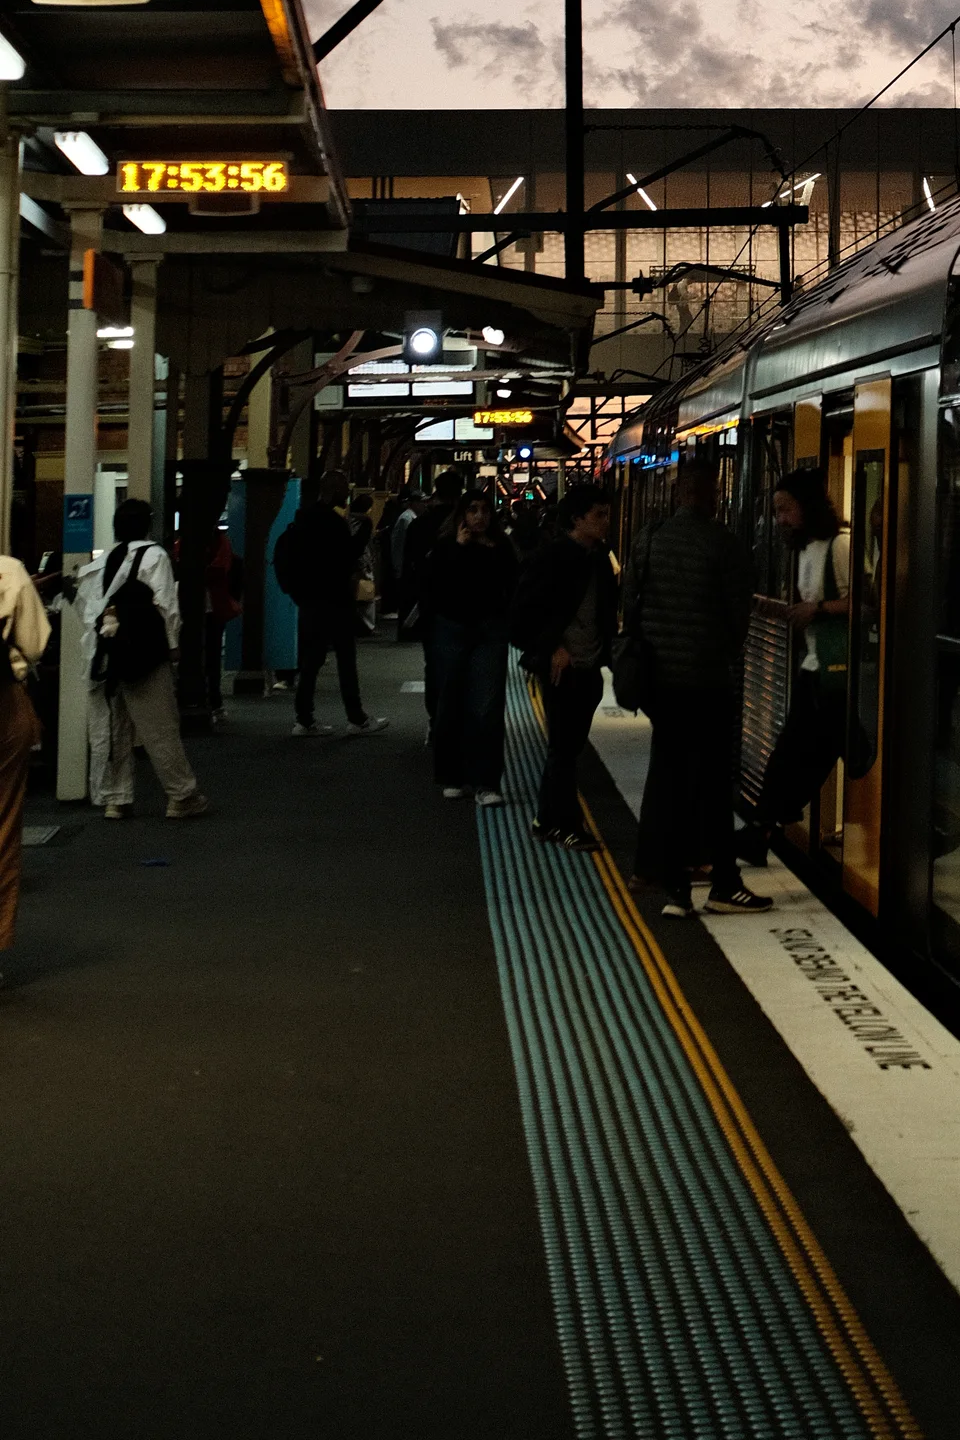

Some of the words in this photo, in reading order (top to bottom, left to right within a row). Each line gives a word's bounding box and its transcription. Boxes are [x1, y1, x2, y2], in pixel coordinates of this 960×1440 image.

[121, 162, 287, 192] 17:53:56
[473, 411, 533, 424] 17:53:56
[453, 450, 473, 462] Lift
[814, 984, 868, 1002] THE
[828, 1003, 909, 1044] YELLOW
[864, 1044, 933, 1071] LINE
